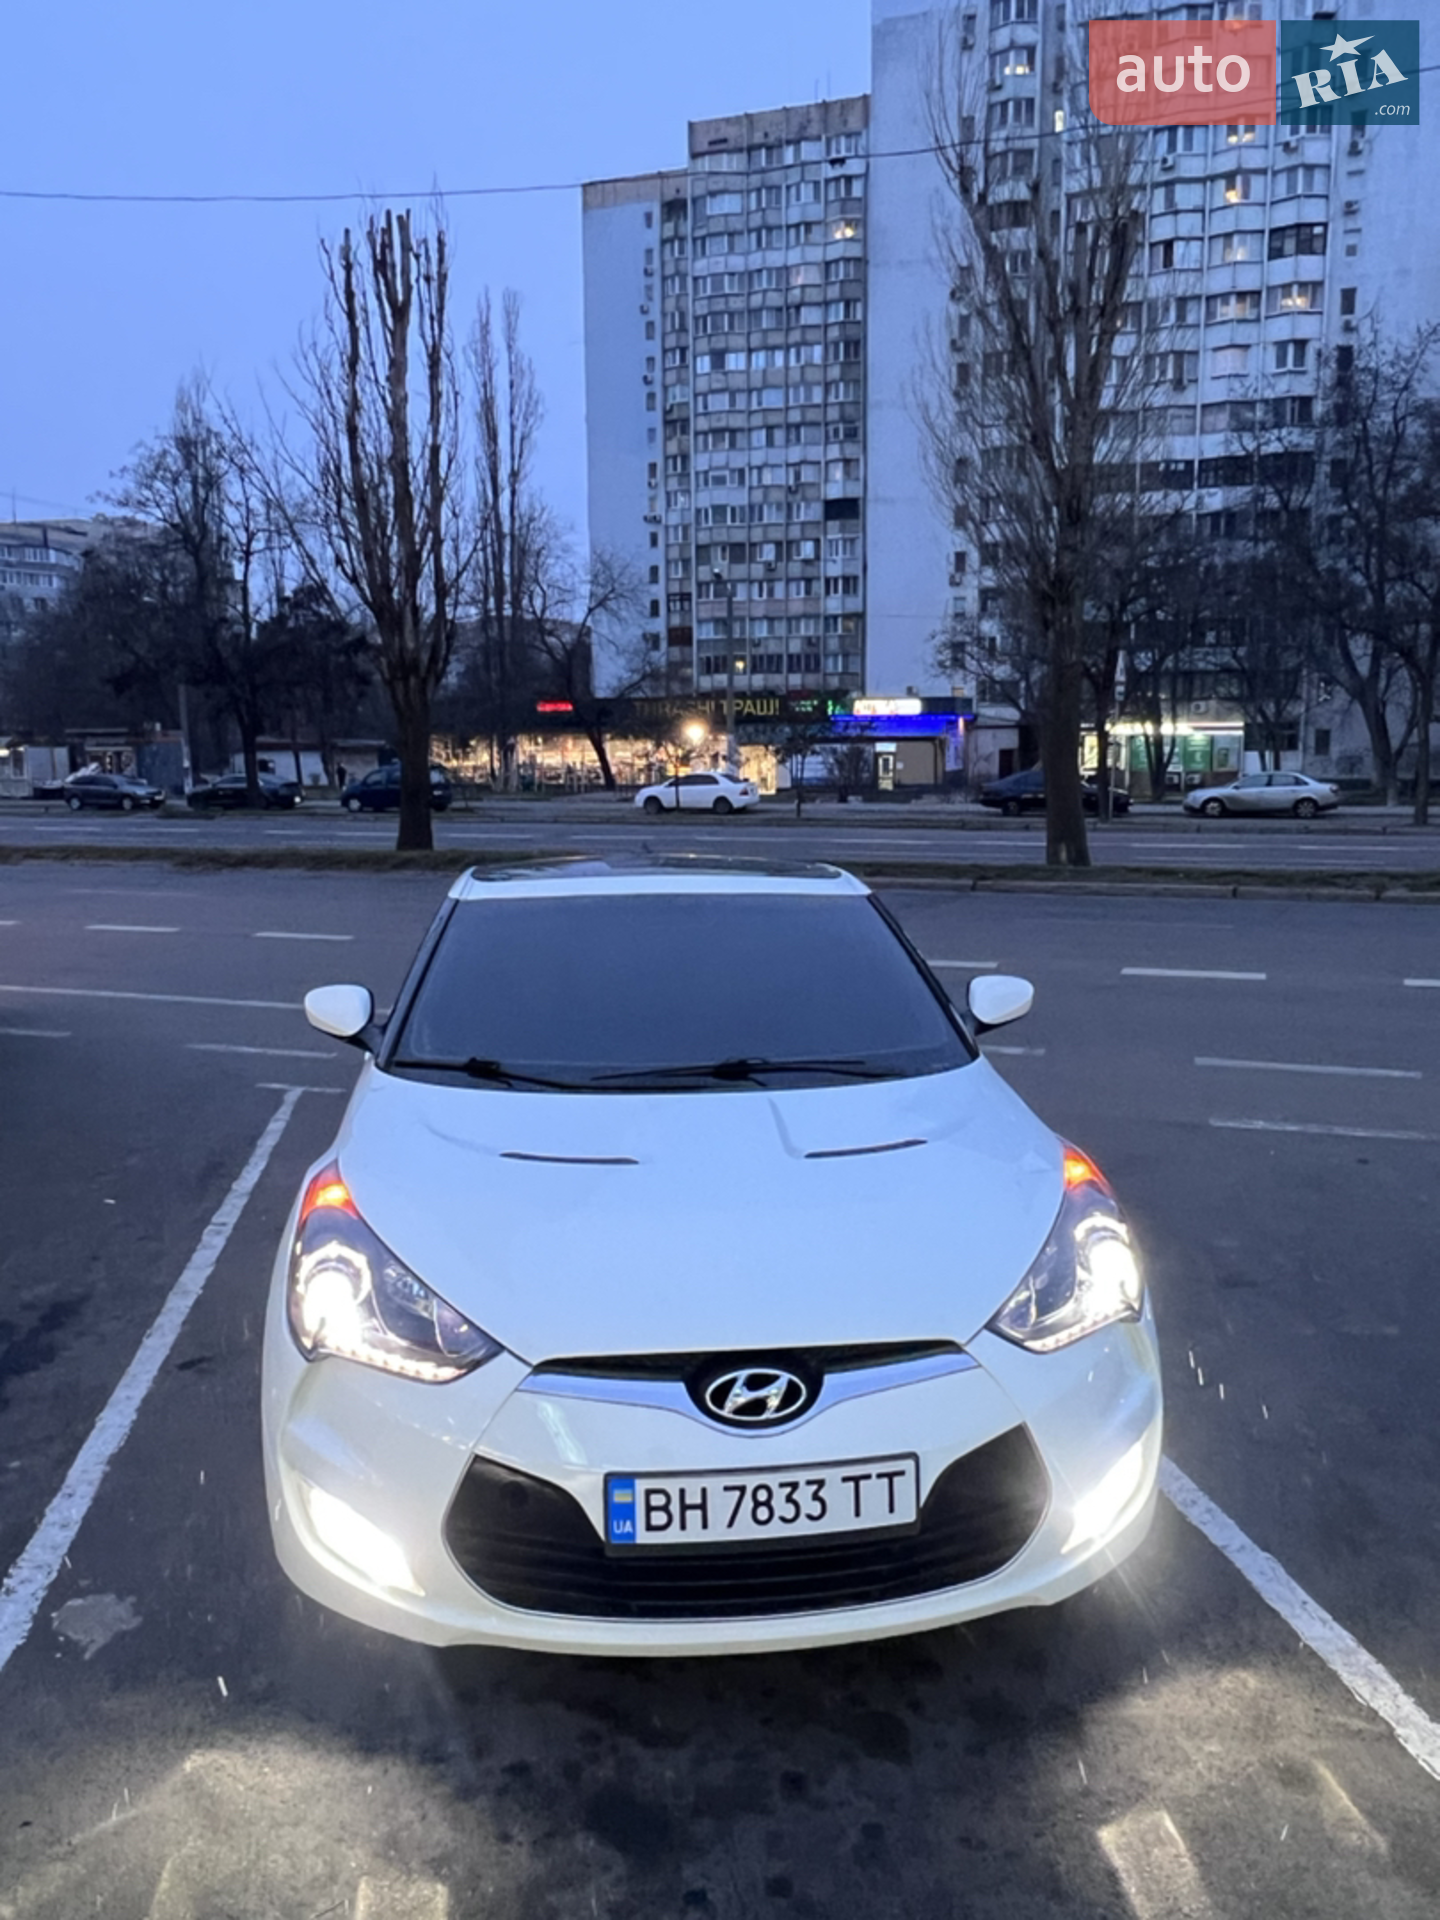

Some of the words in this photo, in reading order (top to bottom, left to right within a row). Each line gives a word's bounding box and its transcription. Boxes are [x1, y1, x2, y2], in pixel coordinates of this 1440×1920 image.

[644, 1488, 708, 1532] BH
[723, 1479, 828, 1528] 7833
[841, 1471, 906, 1518] TT
[613, 1519, 634, 1534] UA
